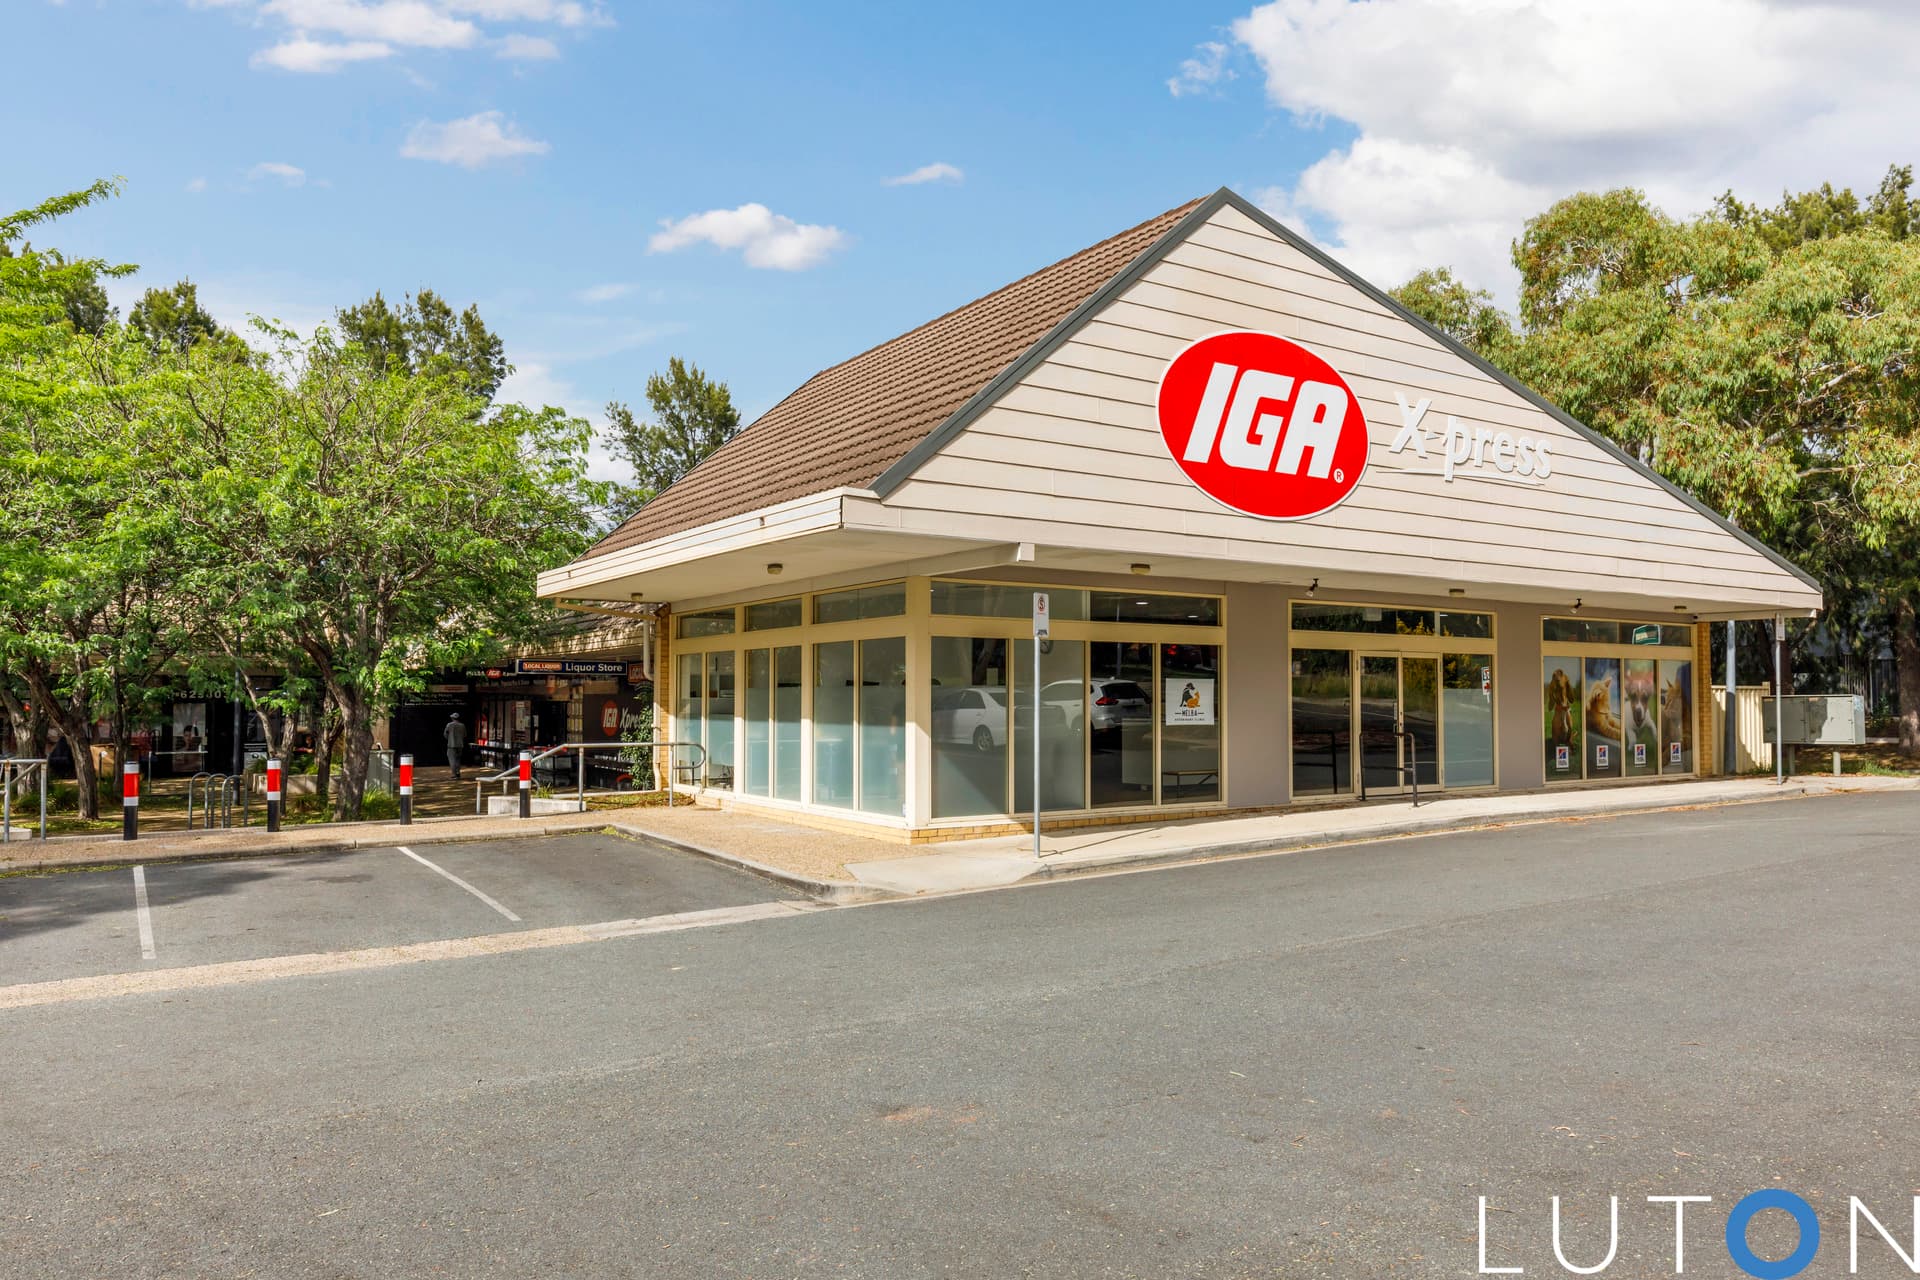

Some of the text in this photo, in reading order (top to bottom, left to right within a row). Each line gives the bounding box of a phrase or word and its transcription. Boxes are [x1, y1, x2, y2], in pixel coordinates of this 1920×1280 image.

[1183, 361, 1349, 480] IGA
[1388, 391, 1553, 483] X-press
[565, 663, 596, 673] Liquor
[598, 663, 623, 673] Store
[603, 708, 618, 728] IGA
